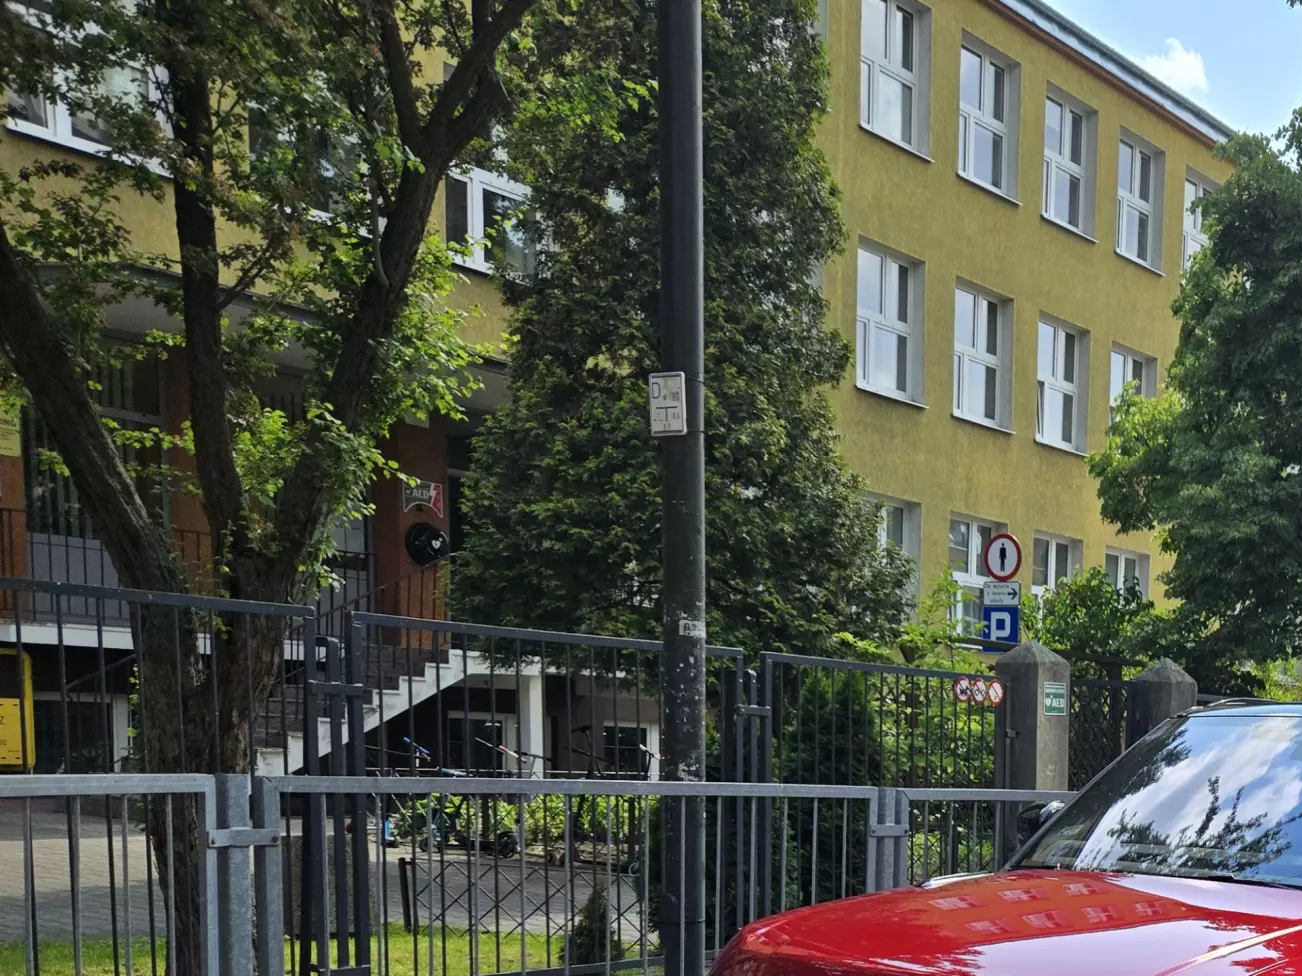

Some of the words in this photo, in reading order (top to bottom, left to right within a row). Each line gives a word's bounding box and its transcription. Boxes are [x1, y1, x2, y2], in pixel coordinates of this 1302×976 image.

[412, 489, 429, 499] AED
[990, 611, 1011, 641] P
[1051, 698, 1065, 708] AED
